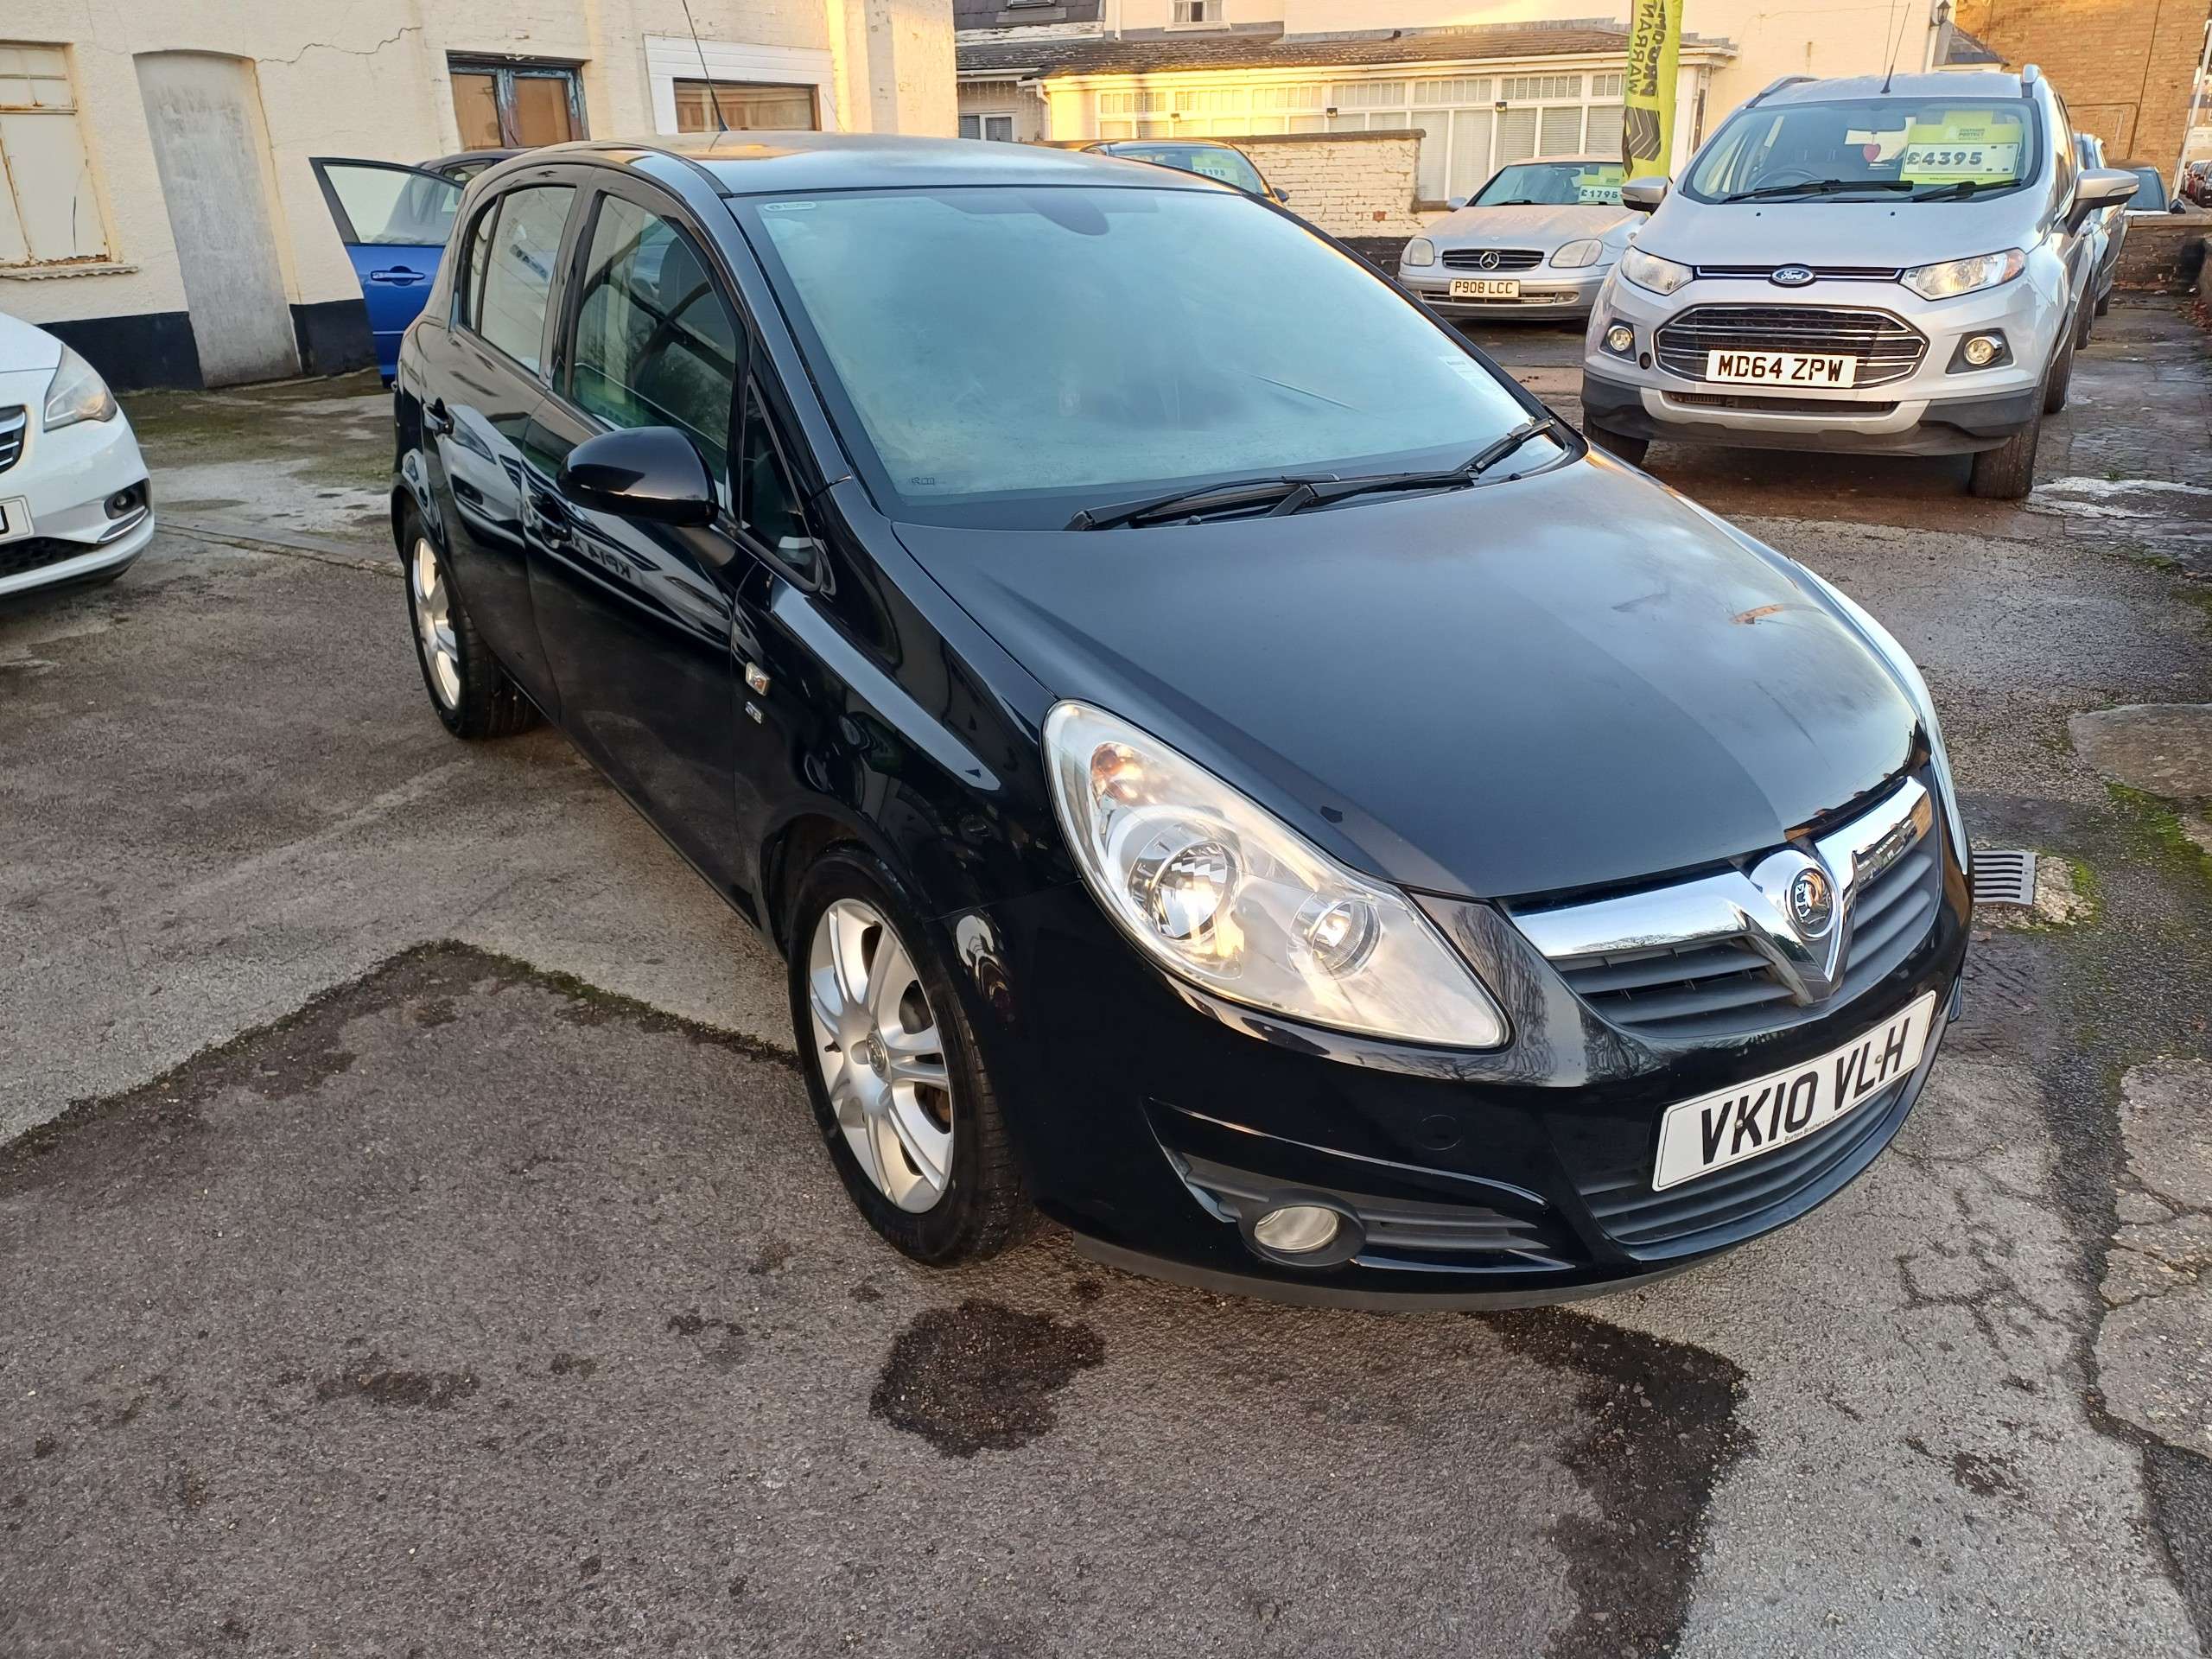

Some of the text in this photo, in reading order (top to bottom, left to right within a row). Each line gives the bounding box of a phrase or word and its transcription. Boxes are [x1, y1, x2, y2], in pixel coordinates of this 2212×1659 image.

[1906, 151, 1982, 165] £4395
[1580, 189, 1618, 199] £1795
[1454, 281, 1513, 294] P908 LCC
[1718, 355, 1844, 382] MD64 ZPW
[1700, 1016, 1911, 1166] VK10 VLH
